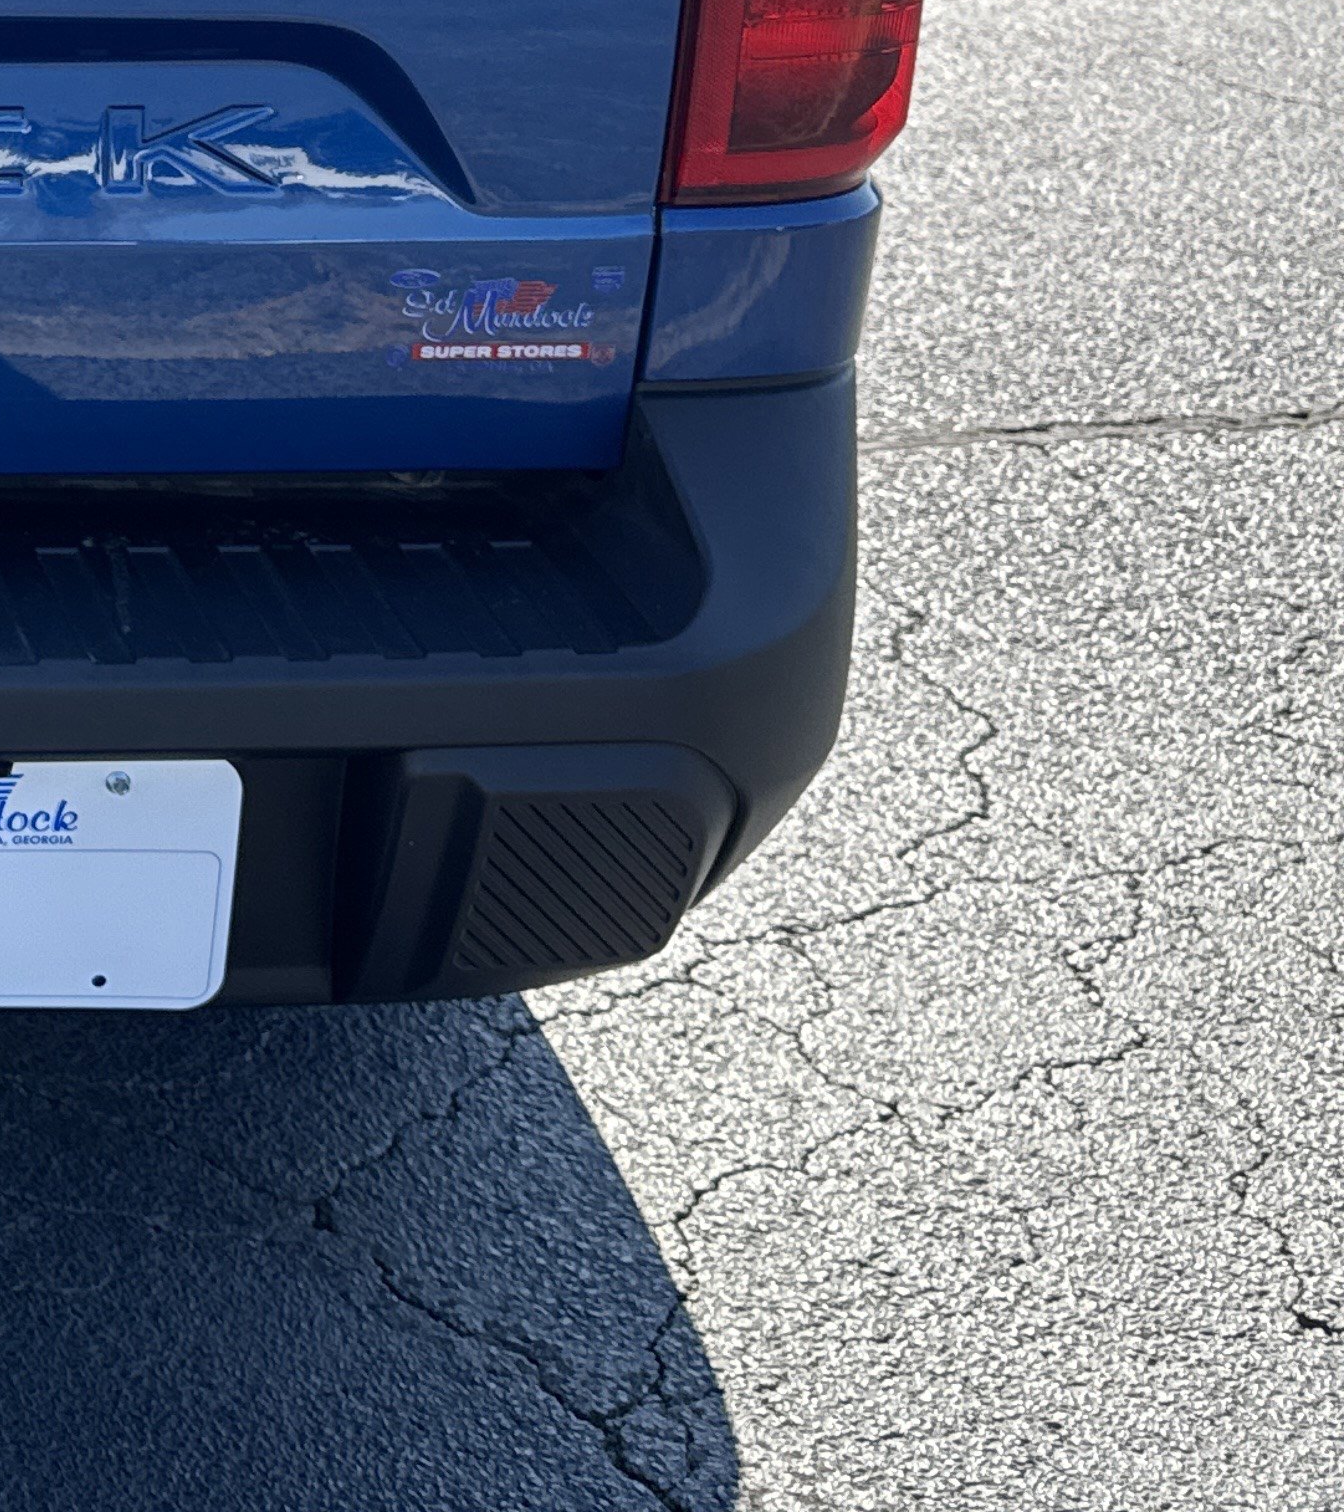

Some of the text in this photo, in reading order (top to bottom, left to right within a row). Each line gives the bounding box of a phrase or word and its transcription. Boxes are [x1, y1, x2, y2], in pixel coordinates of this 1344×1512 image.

[402, 285, 595, 342] Ed Murdock
[420, 345, 582, 359] SUPER STORES
[12, 834, 74, 845] GEORGIA
